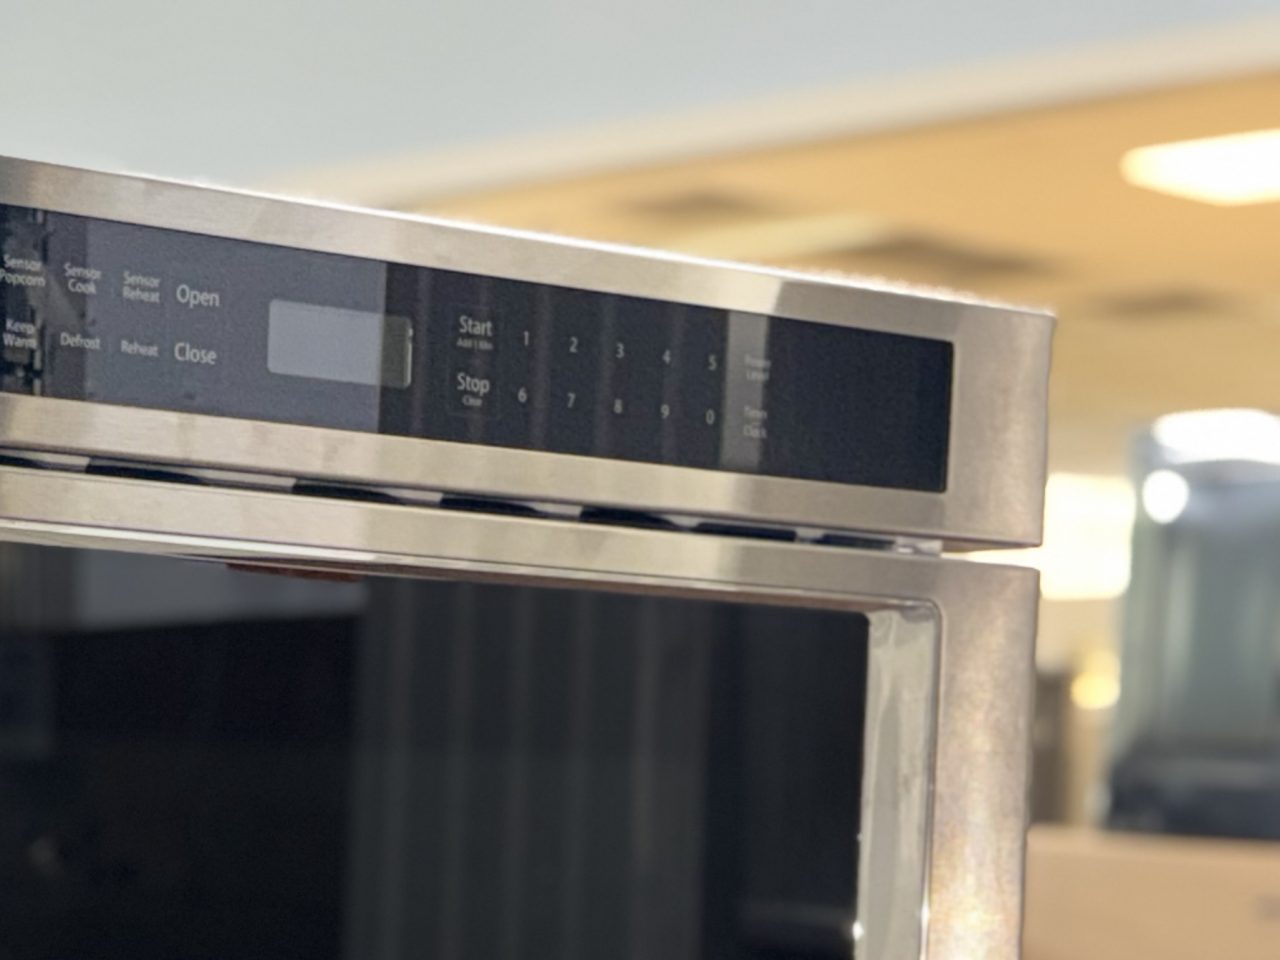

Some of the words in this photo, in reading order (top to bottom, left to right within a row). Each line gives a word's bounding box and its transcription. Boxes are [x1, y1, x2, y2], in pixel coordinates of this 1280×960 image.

[3, 254, 42, 271] Sensor
[64, 261, 102, 280] Sensor
[68, 278, 97, 295] Cook
[123, 271, 160, 288] Sensor
[122, 285, 160, 303] Reheat
[176, 284, 220, 309] Open
[5, 317, 35, 335] Keep
[458, 314, 493, 337] Start
[2, 332, 37, 350] Warm
[60, 331, 100, 350] Defrost
[120, 339, 158, 358] Reheat
[174, 341, 217, 365] Close
[523, 330, 530, 347] 1
[568, 336, 578, 354] 2
[616, 342, 625, 359] 3
[662, 349, 671, 365] 4
[708, 354, 717, 371] 5
[456, 371, 490, 397] Stop
[517, 386, 528, 404] 6
[566, 392, 576, 409] 7
[613, 398, 623, 415] 8
[660, 403, 670, 420] 9
[705, 408, 716, 425] 0
